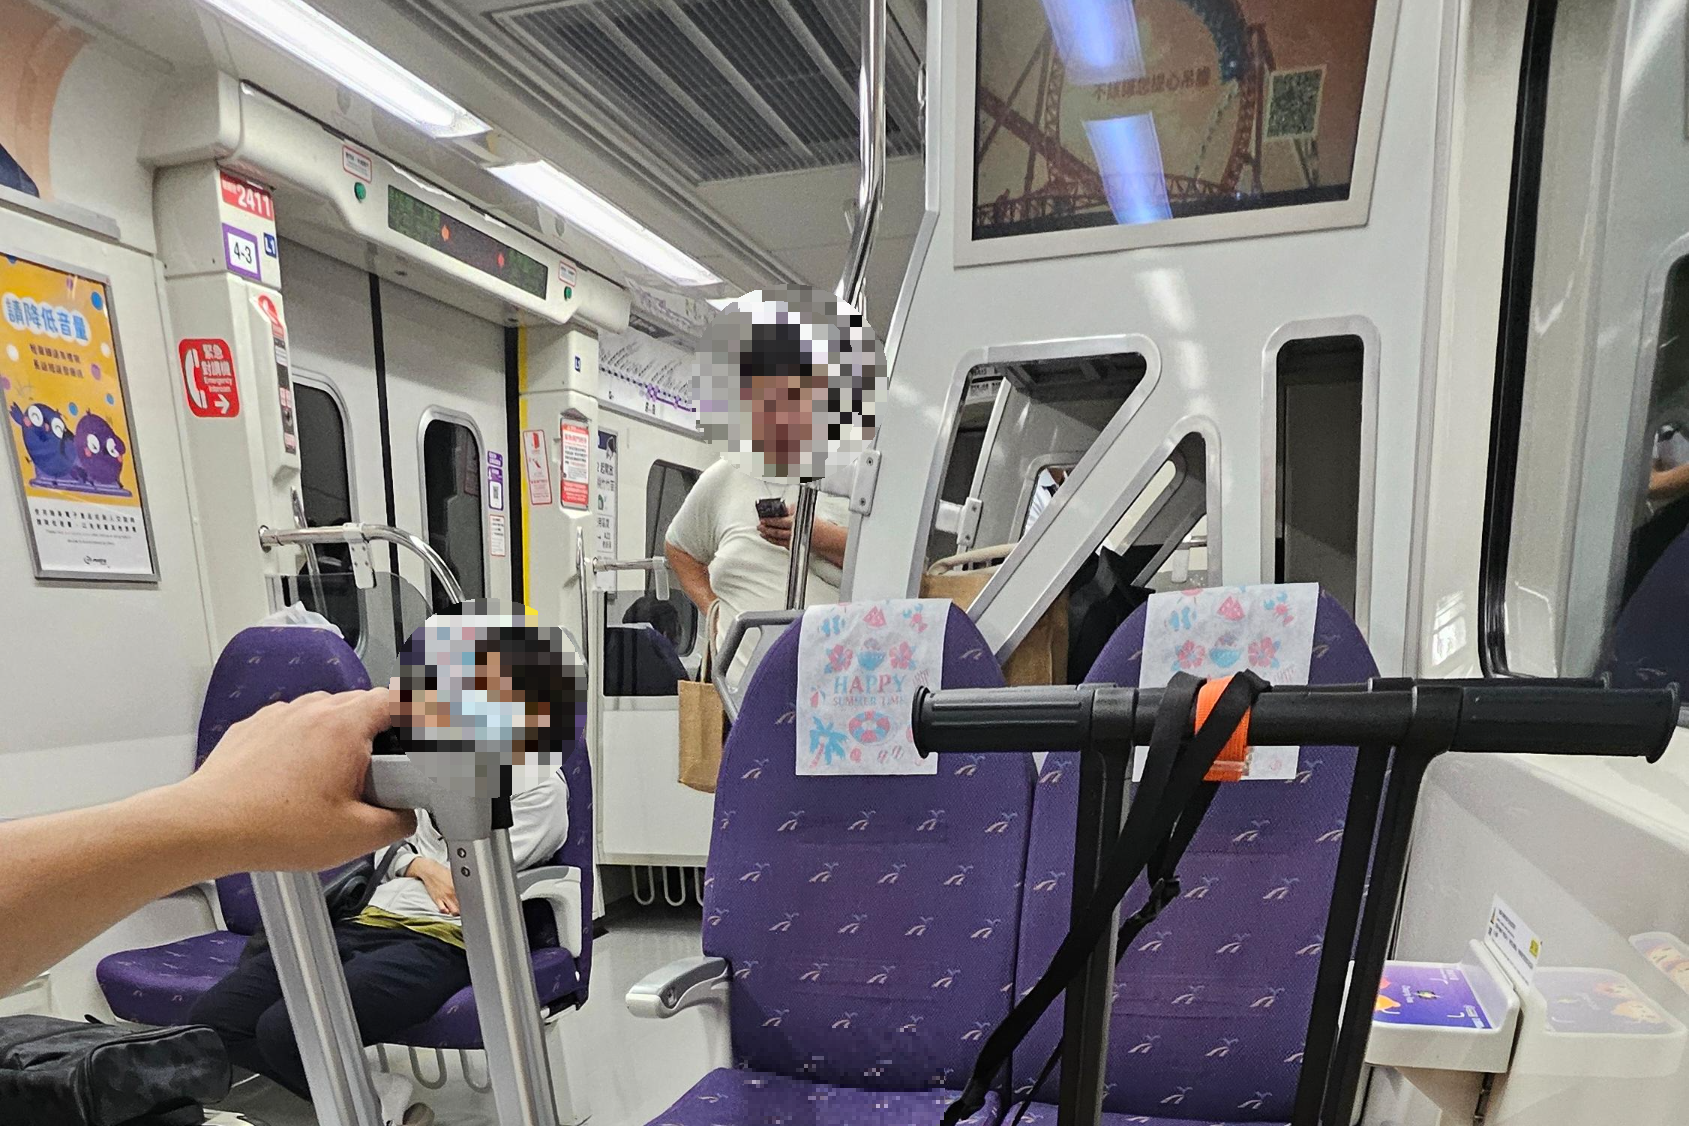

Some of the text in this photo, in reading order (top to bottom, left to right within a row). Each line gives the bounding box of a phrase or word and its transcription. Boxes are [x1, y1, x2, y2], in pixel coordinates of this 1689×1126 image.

[235, 184, 271, 217] 2411
[233, 242, 252, 265] 4-3
[265, 237, 275, 255] L1
[5, 298, 89, 341] 請降低音量
[833, 674, 907, 695] HAPPY
[833, 693, 877, 707] SUMMER
